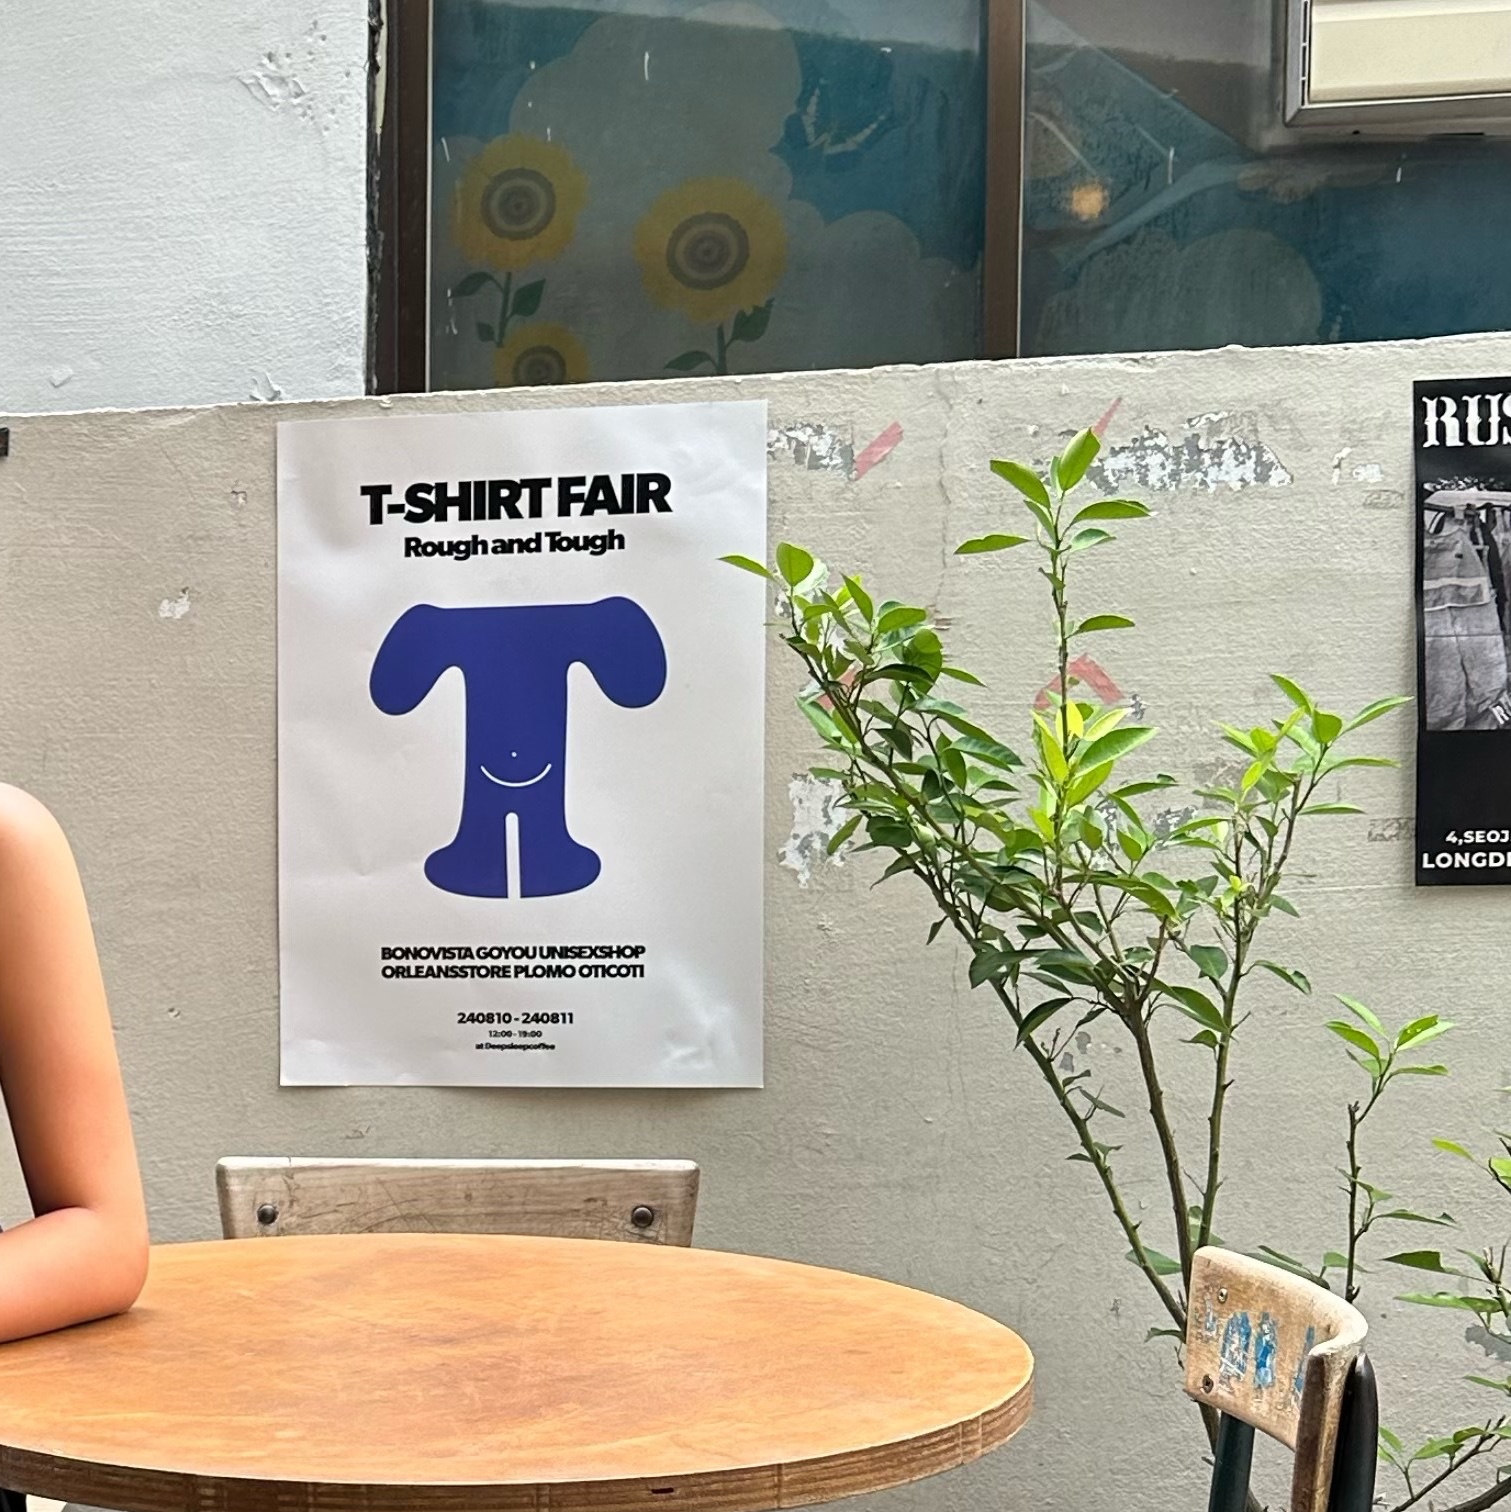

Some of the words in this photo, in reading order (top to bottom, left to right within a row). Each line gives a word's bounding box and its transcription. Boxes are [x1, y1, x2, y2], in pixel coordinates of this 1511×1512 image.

[360, 477, 552, 525] T-SHIRT
[557, 472, 674, 518] FAIR
[404, 534, 488, 561] Rough
[491, 532, 541, 555] and
[545, 529, 626, 556] Tough
[1422, 852, 1511, 869] LONGD
[381, 946, 475, 961] BONOVISTA
[475, 946, 537, 960] GOYOU
[538, 945, 646, 959] UNISEXSHOP
[381, 965, 512, 979] ORLEANSSTORE
[513, 964, 576, 979] PLOMO
[578, 964, 645, 978] OTICOTI
[457, 1012, 512, 1024] 240810
[521, 1011, 574, 1024] 240811
